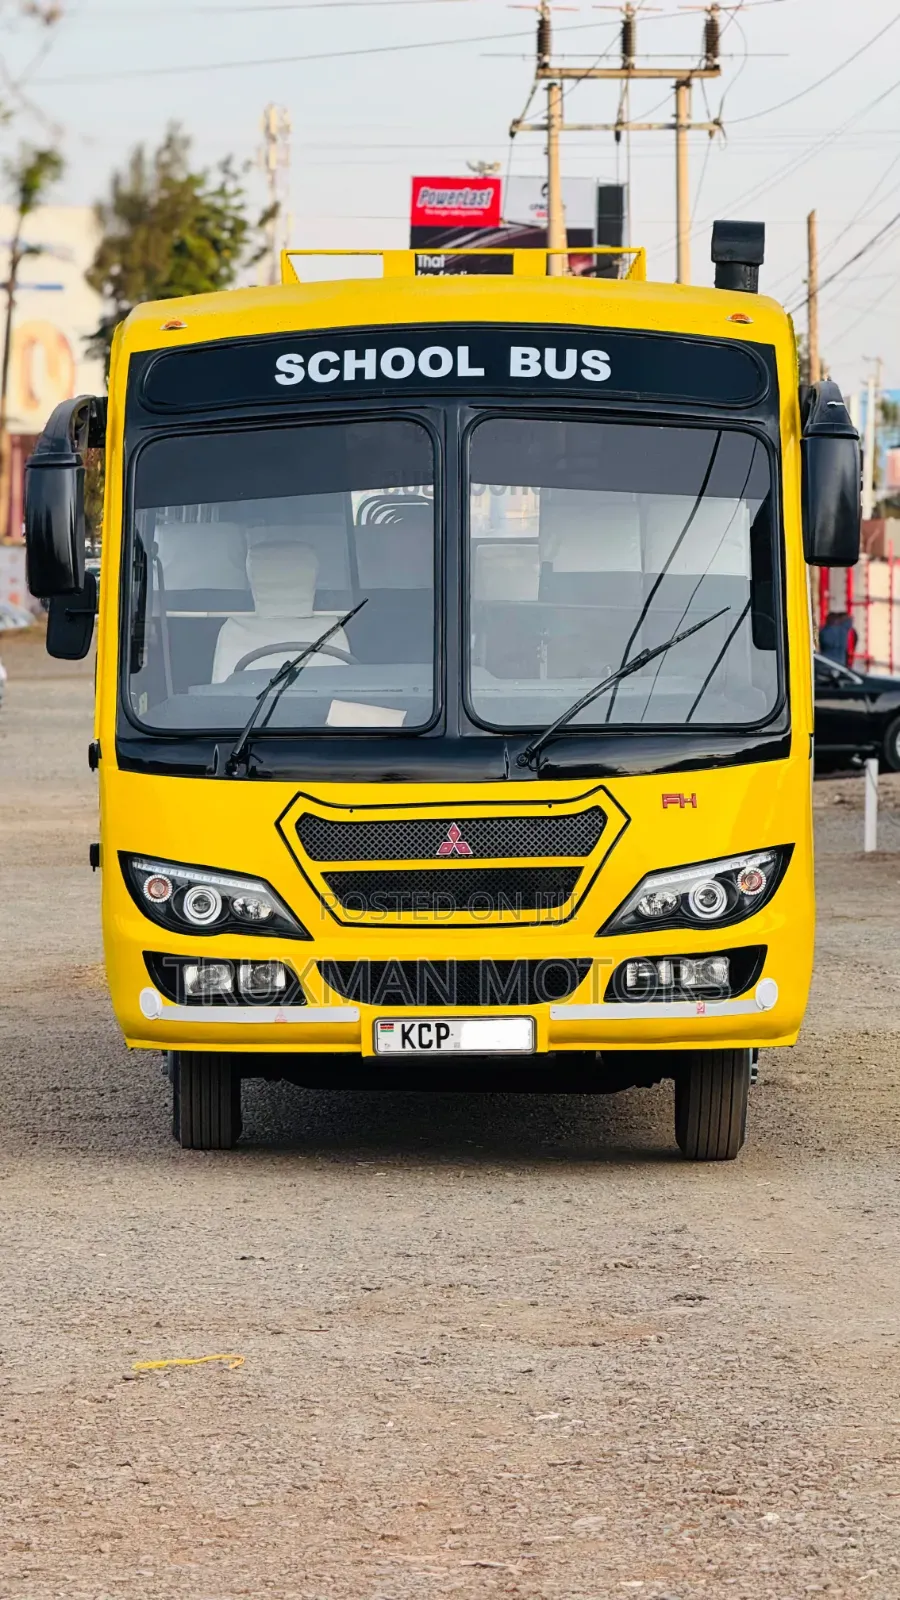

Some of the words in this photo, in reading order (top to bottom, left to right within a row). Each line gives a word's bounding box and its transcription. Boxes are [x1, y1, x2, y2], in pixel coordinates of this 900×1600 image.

[417, 187, 493, 208] PowerLast
[417, 255, 445, 268] That
[274, 346, 485, 386] SCHOOL
[510, 346, 612, 382] BUS
[661, 793, 697, 809] FH
[401, 1023, 450, 1049] KCP
